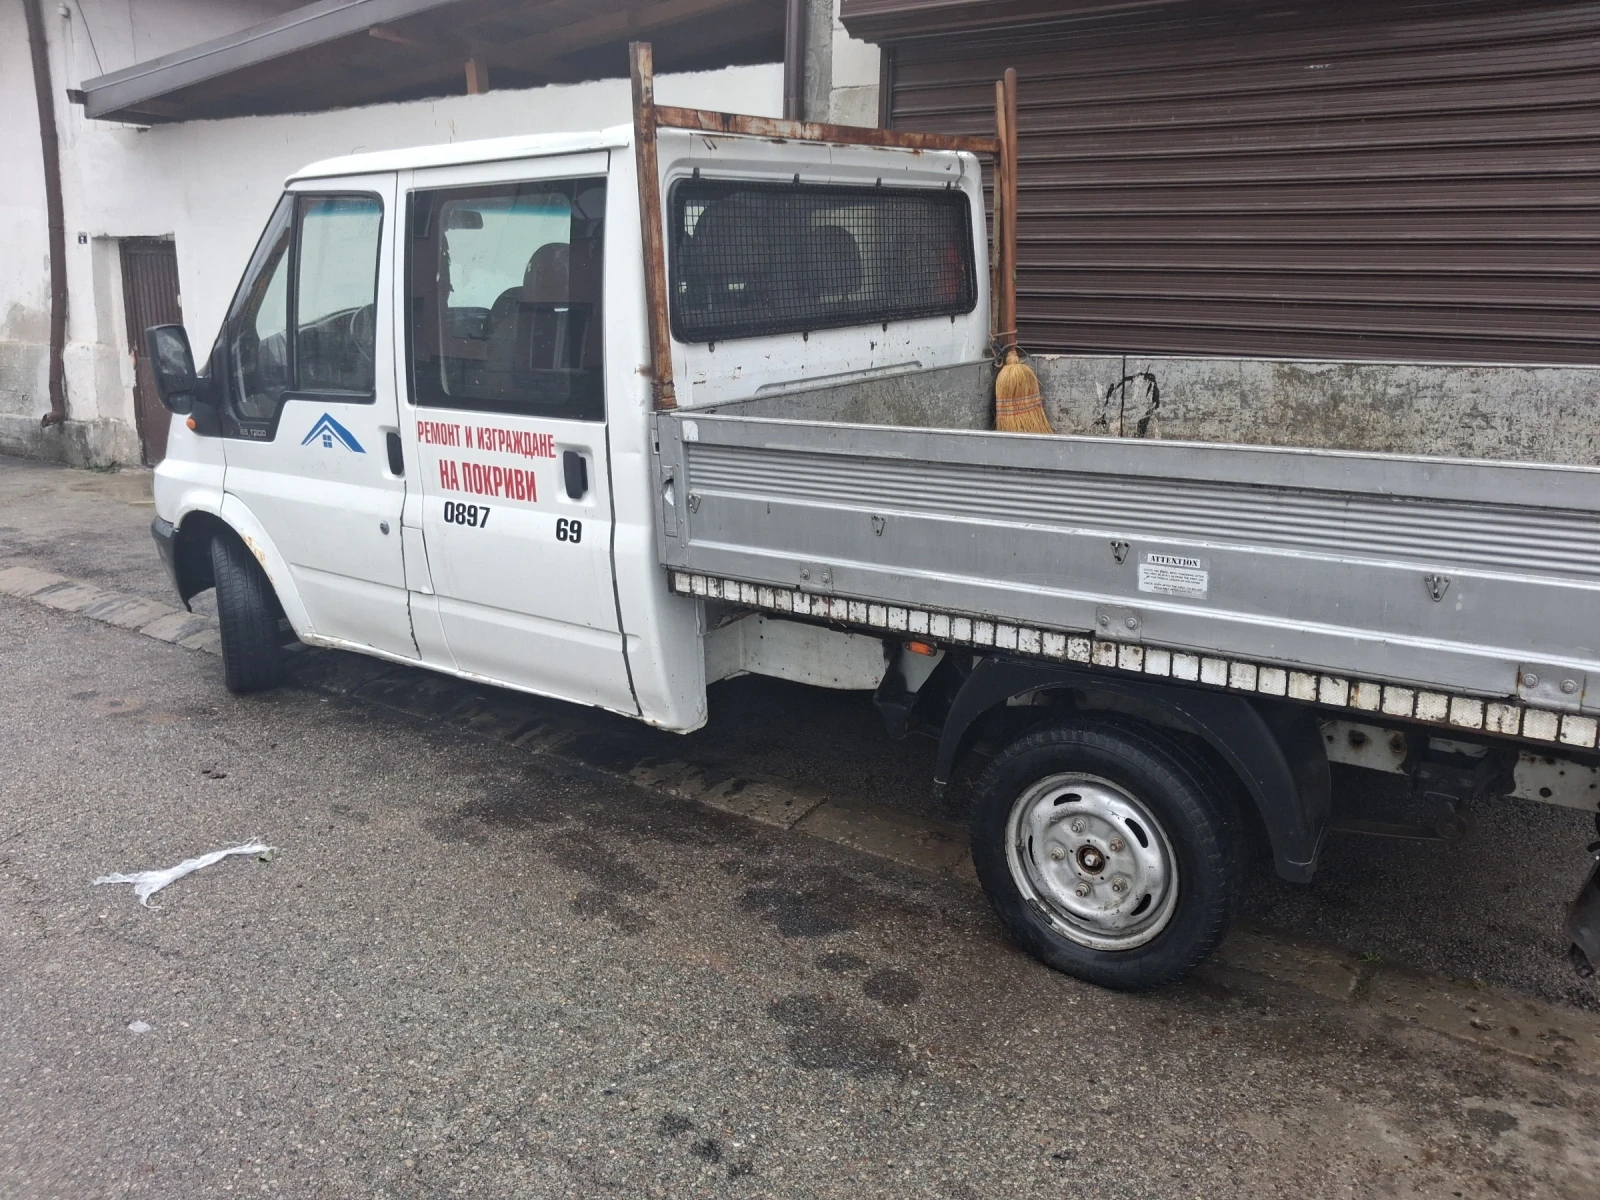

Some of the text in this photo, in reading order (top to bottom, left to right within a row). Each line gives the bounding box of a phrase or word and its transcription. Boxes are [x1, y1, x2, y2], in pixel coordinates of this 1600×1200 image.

[417, 420, 556, 459] РЕМОНТ И ИЗГРАЖДАНЕ
[439, 459, 537, 502] НА ПОКРИВИ
[444, 501, 582, 543] 0897 69
[1151, 555, 1198, 566] ATTENTION
